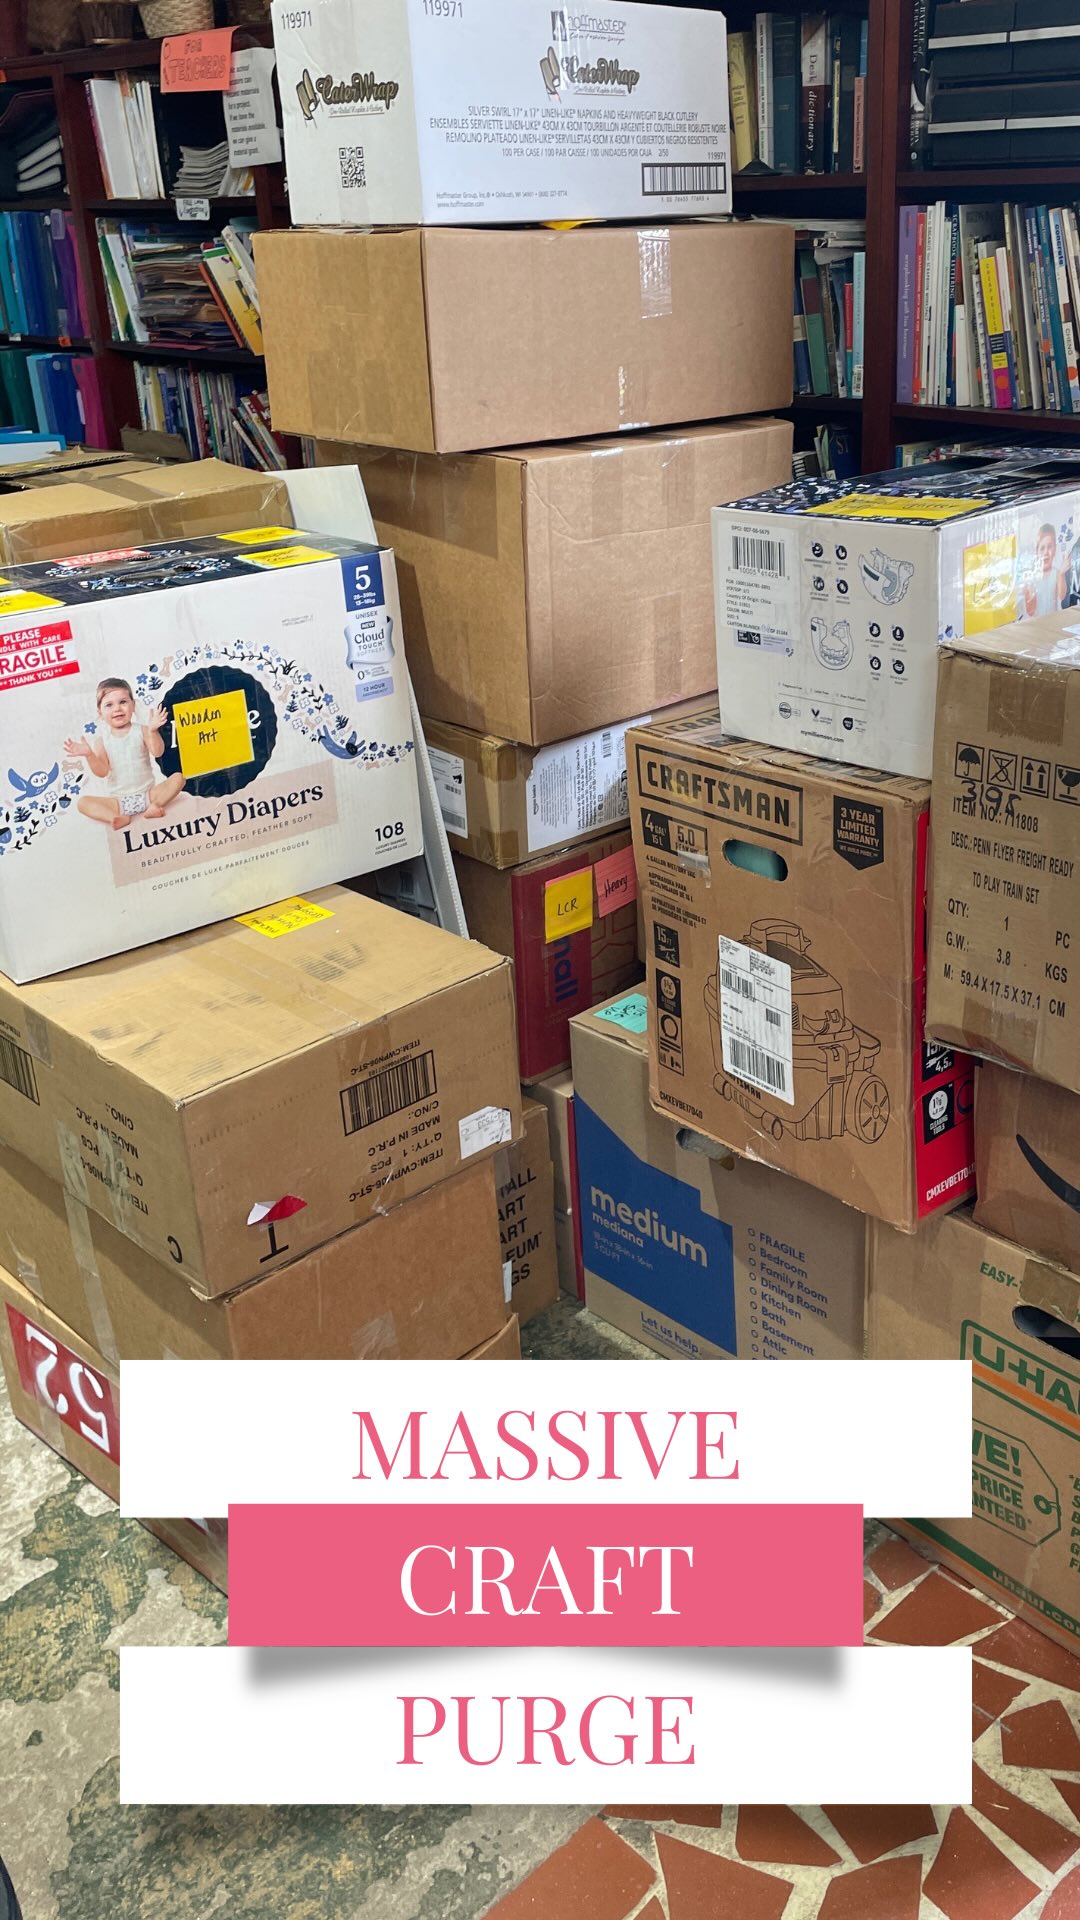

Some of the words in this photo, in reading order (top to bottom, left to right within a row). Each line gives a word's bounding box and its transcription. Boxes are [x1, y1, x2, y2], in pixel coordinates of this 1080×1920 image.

[281, 10, 312, 29] 119971
[422, 0, 463, 18] 119971
[184, 38, 202, 54] FOR
[169, 54, 226, 84] TEACHERS
[809, 54, 818, 83] Desk
[468, 105, 490, 117] SILVER
[491, 106, 512, 117] SWIRL
[524, 110, 528, 118] x
[577, 109, 603, 119] NAPKINS
[603, 110, 616, 120] AND
[617, 110, 658, 121] HEAVYWEIGHT
[658, 111, 675, 121] BLACK
[675, 112, 698, 122] CUTLERY
[430, 118, 469, 129] ENSEMBLES
[470, 119, 503, 130] SERVIETTE
[542, 120, 559, 131] 43CM
[561, 121, 565, 131] X
[566, 121, 583, 132] 43CM
[583, 122, 620, 132] TOURBILLON
[620, 121, 645, 133] ARGENTÉ
[646, 123, 651, 133] ET
[653, 123, 687, 133] COUTELLERIE
[687, 124, 710, 134] ROBUSTE
[711, 124, 726, 134] NOIRE
[445, 132, 482, 143] REMOLINO
[483, 133, 517, 143] PLATEADO
[555, 134, 591, 144] SERVILLETAS
[592, 134, 609, 144] 43CM
[609, 135, 614, 144] X
[614, 135, 631, 145] 43CM
[631, 135, 635, 145] Y
[636, 135, 664, 145] CUBIERTOS
[665, 136, 687, 145] NEGROS
[687, 136, 718, 145] RESISTENTES
[708, 151, 726, 160] 119971
[1064, 328, 1073, 356] CHENG
[355, 565, 371, 591] 5
[355, 610, 378, 620] UNISEX
[362, 621, 375, 629] NEW
[3, 629, 41, 645] PLEASE
[19, 639, 40, 649] WITH
[42, 634, 61, 644] CARE
[354, 628, 385, 645] Cloud
[179, 708, 222, 727] Wooden
[198, 729, 219, 745] Art
[647, 760, 790, 828] CRAFTSMAN
[840, 807, 847, 818] 3
[850, 808, 875, 825] YEAR
[952, 797, 977, 818] ITEM
[123, 811, 222, 854] Luxury
[227, 784, 324, 826] Diapers
[644, 813, 655, 833] 4
[840, 819, 876, 837] LIMITED
[140, 844, 203, 869] BEAUTIFULLY
[205, 832, 250, 850] CRAFTED,
[251, 820, 290, 838] FEATHER
[292, 813, 313, 827] SOFT
[374, 821, 405, 842] 108
[677, 825, 695, 847] 5.0
[836, 829, 880, 847] WARRANTY
[151, 876, 190, 891] COUCHES
[191, 872, 201, 880] DE
[204, 866, 223, 876] LUXE
[225, 848, 280, 871] PARFAITEMENT
[281, 839, 311, 855] DOUCES
[973, 836, 991, 856] PENN
[993, 841, 1015, 863] FLYER
[1017, 848, 1048, 871] FREIGHT
[1049, 855, 1074, 879] READY
[972, 871, 981, 887] TO
[983, 874, 1001, 894] PLAY
[1002, 879, 1024, 901] TRAIN
[1025, 887, 1040, 905] SET
[557, 898, 578, 917] LCR
[948, 898, 970, 919] QTY:
[1003, 915, 1009, 931] 1
[656, 925, 667, 943] 15
[946, 931, 970, 953] G.W.:
[1055, 930, 1070, 950] PC
[996, 948, 1011, 966] 3.8
[1044, 961, 1068, 984] KGS
[943, 963, 954, 981] M:
[960, 969, 980, 990] 59.4
[981, 976, 988, 992] X
[989, 979, 1010, 1000] 17.5
[1011, 986, 1018, 1002] X
[1020, 990, 1041, 1011] 37.1
[1048, 998, 1066, 1018] CM
[411, 1114, 441, 1137] MADE
[398, 1131, 409, 1143] IN
[403, 1147, 408, 1158] 1
[369, 1156, 392, 1174] PCS
[590, 1185, 708, 1269] medium
[592, 1212, 645, 1248] mediana
[167, 1234, 183, 1264] C
[759, 1231, 806, 1263] FRAGILE
[759, 1247, 808, 1280] Bedroom
[760, 1263, 796, 1290] Family
[796, 1280, 829, 1305] Room
[980, 1261, 1023, 1293] EASY-
[760, 1277, 795, 1304] Dining
[796, 1294, 828, 1319] Room
[761, 1291, 802, 1320] Kitchen
[640, 1311, 658, 1331] Let
[660, 1324, 673, 1338] us
[762, 1306, 787, 1327] Bath
[762, 1320, 815, 1356] Basement
[762, 1335, 788, 1356] Attic
[972, 1333, 1080, 1415] U-HA
